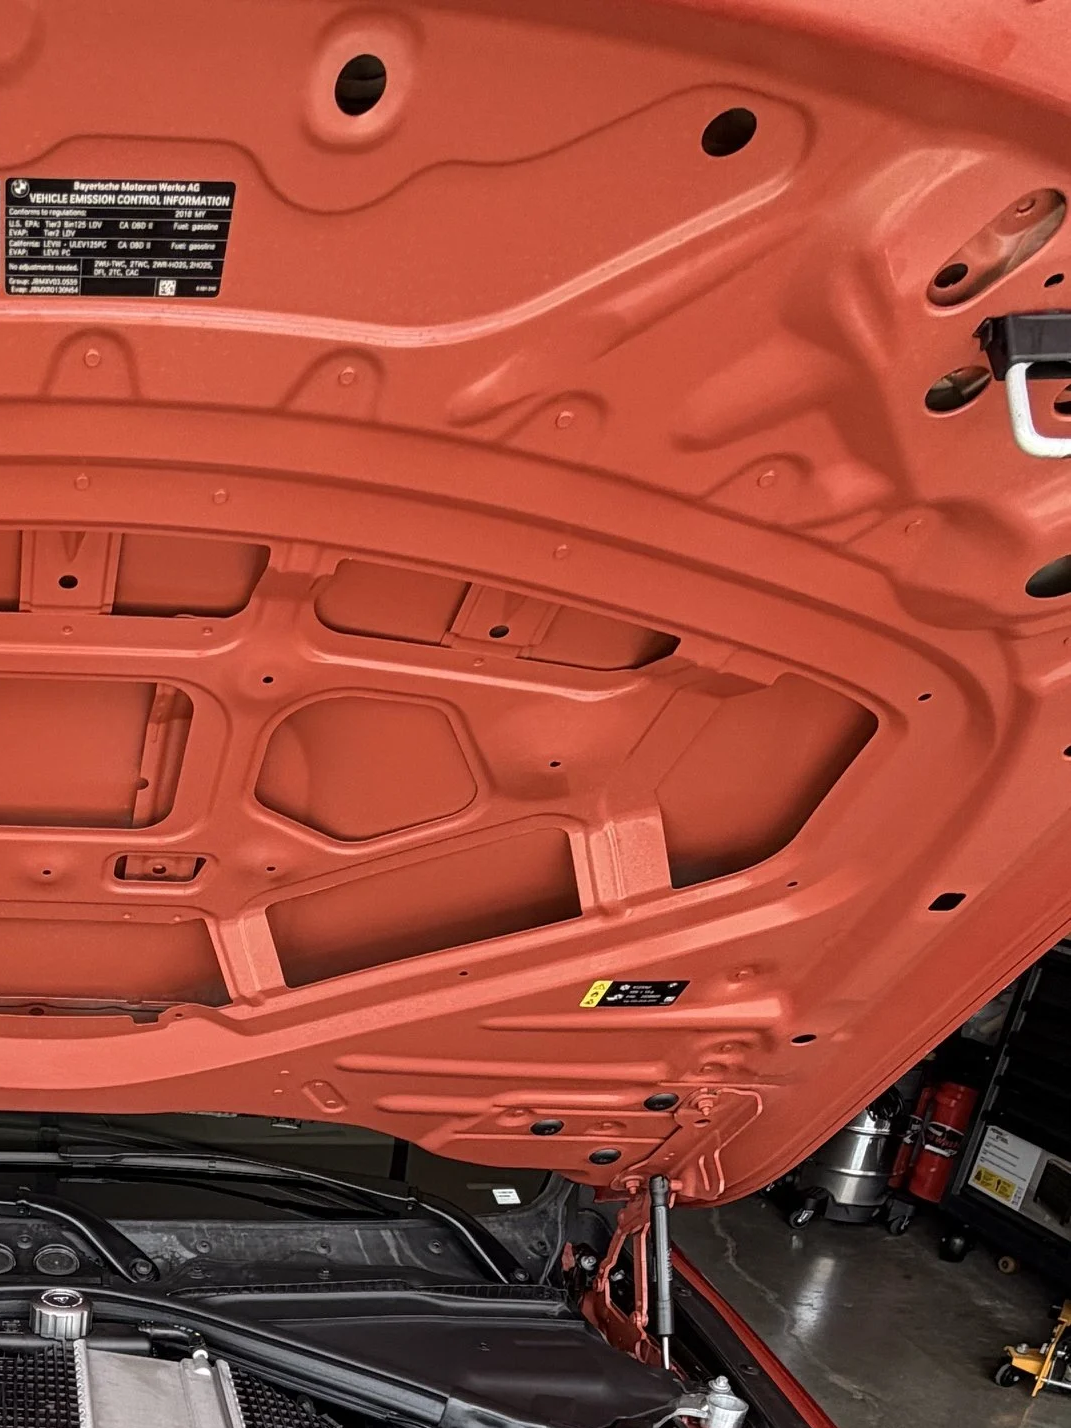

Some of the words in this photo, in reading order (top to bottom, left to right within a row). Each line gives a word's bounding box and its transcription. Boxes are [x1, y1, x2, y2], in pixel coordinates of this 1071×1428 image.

[73, 181, 119, 192] Bayerische
[121, 182, 157, 192] Motoren
[159, 183, 186, 192] Werke
[187, 183, 200, 192] AG
[30, 193, 68, 204] VEHICLE
[69, 193, 115, 205] EMISSION
[117, 194, 161, 206] CONTROL
[163, 195, 230, 207] INFORMATION
[9, 208, 40, 216] Conforms
[41, 208, 48, 216] to
[175, 210, 192, 218] 2018
[194, 210, 206, 218] MY
[88, 221, 103, 229] LDV
[119, 221, 129, 230] CA
[191, 223, 219, 232] gasoline
[117, 241, 128, 249] CA
[188, 243, 216, 251] gasoline
[9, 263, 18, 271] No
